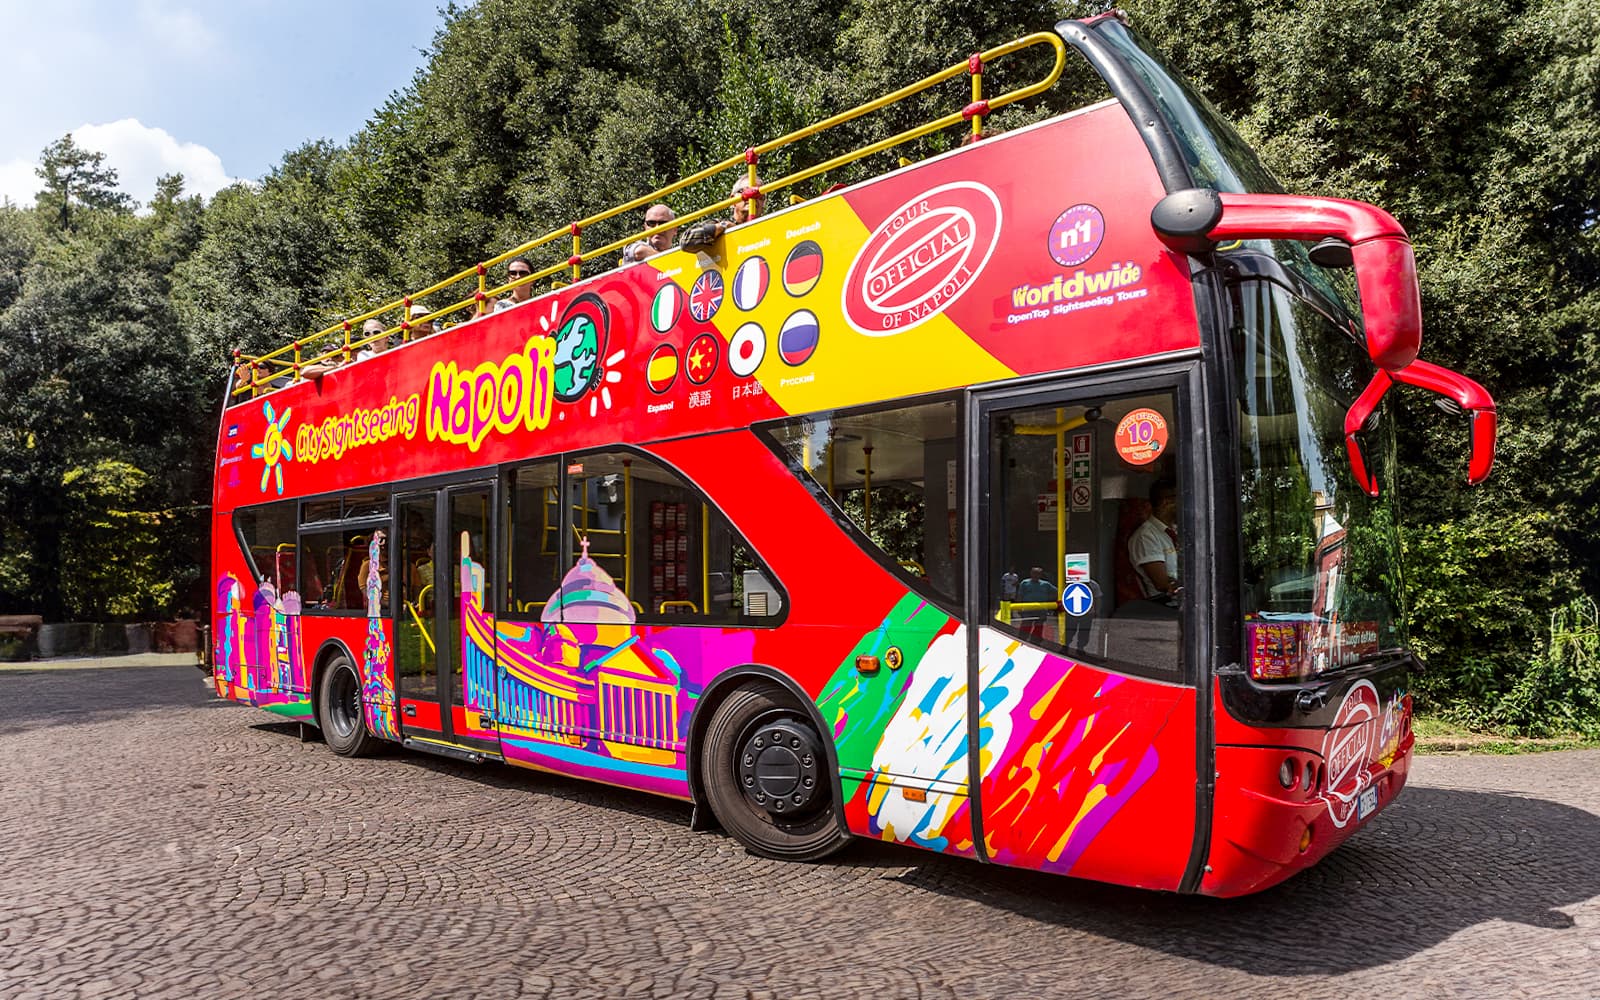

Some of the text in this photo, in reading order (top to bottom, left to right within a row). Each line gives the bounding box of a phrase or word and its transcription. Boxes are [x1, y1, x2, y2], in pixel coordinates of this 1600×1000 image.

[786, 223, 821, 238] Deutsch
[882, 200, 931, 239] TOUR
[870, 225, 968, 296] OFFICIAL
[882, 264, 974, 329] OF NAPOLI
[1011, 261, 1142, 308] Worldwide
[1052, 294, 1114, 315] Sightseeing
[1116, 288, 1148, 302] Tours
[426, 336, 556, 452] Napoli
[732, 382, 764, 400] 日本語
[1127, 420, 1154, 444] 10
